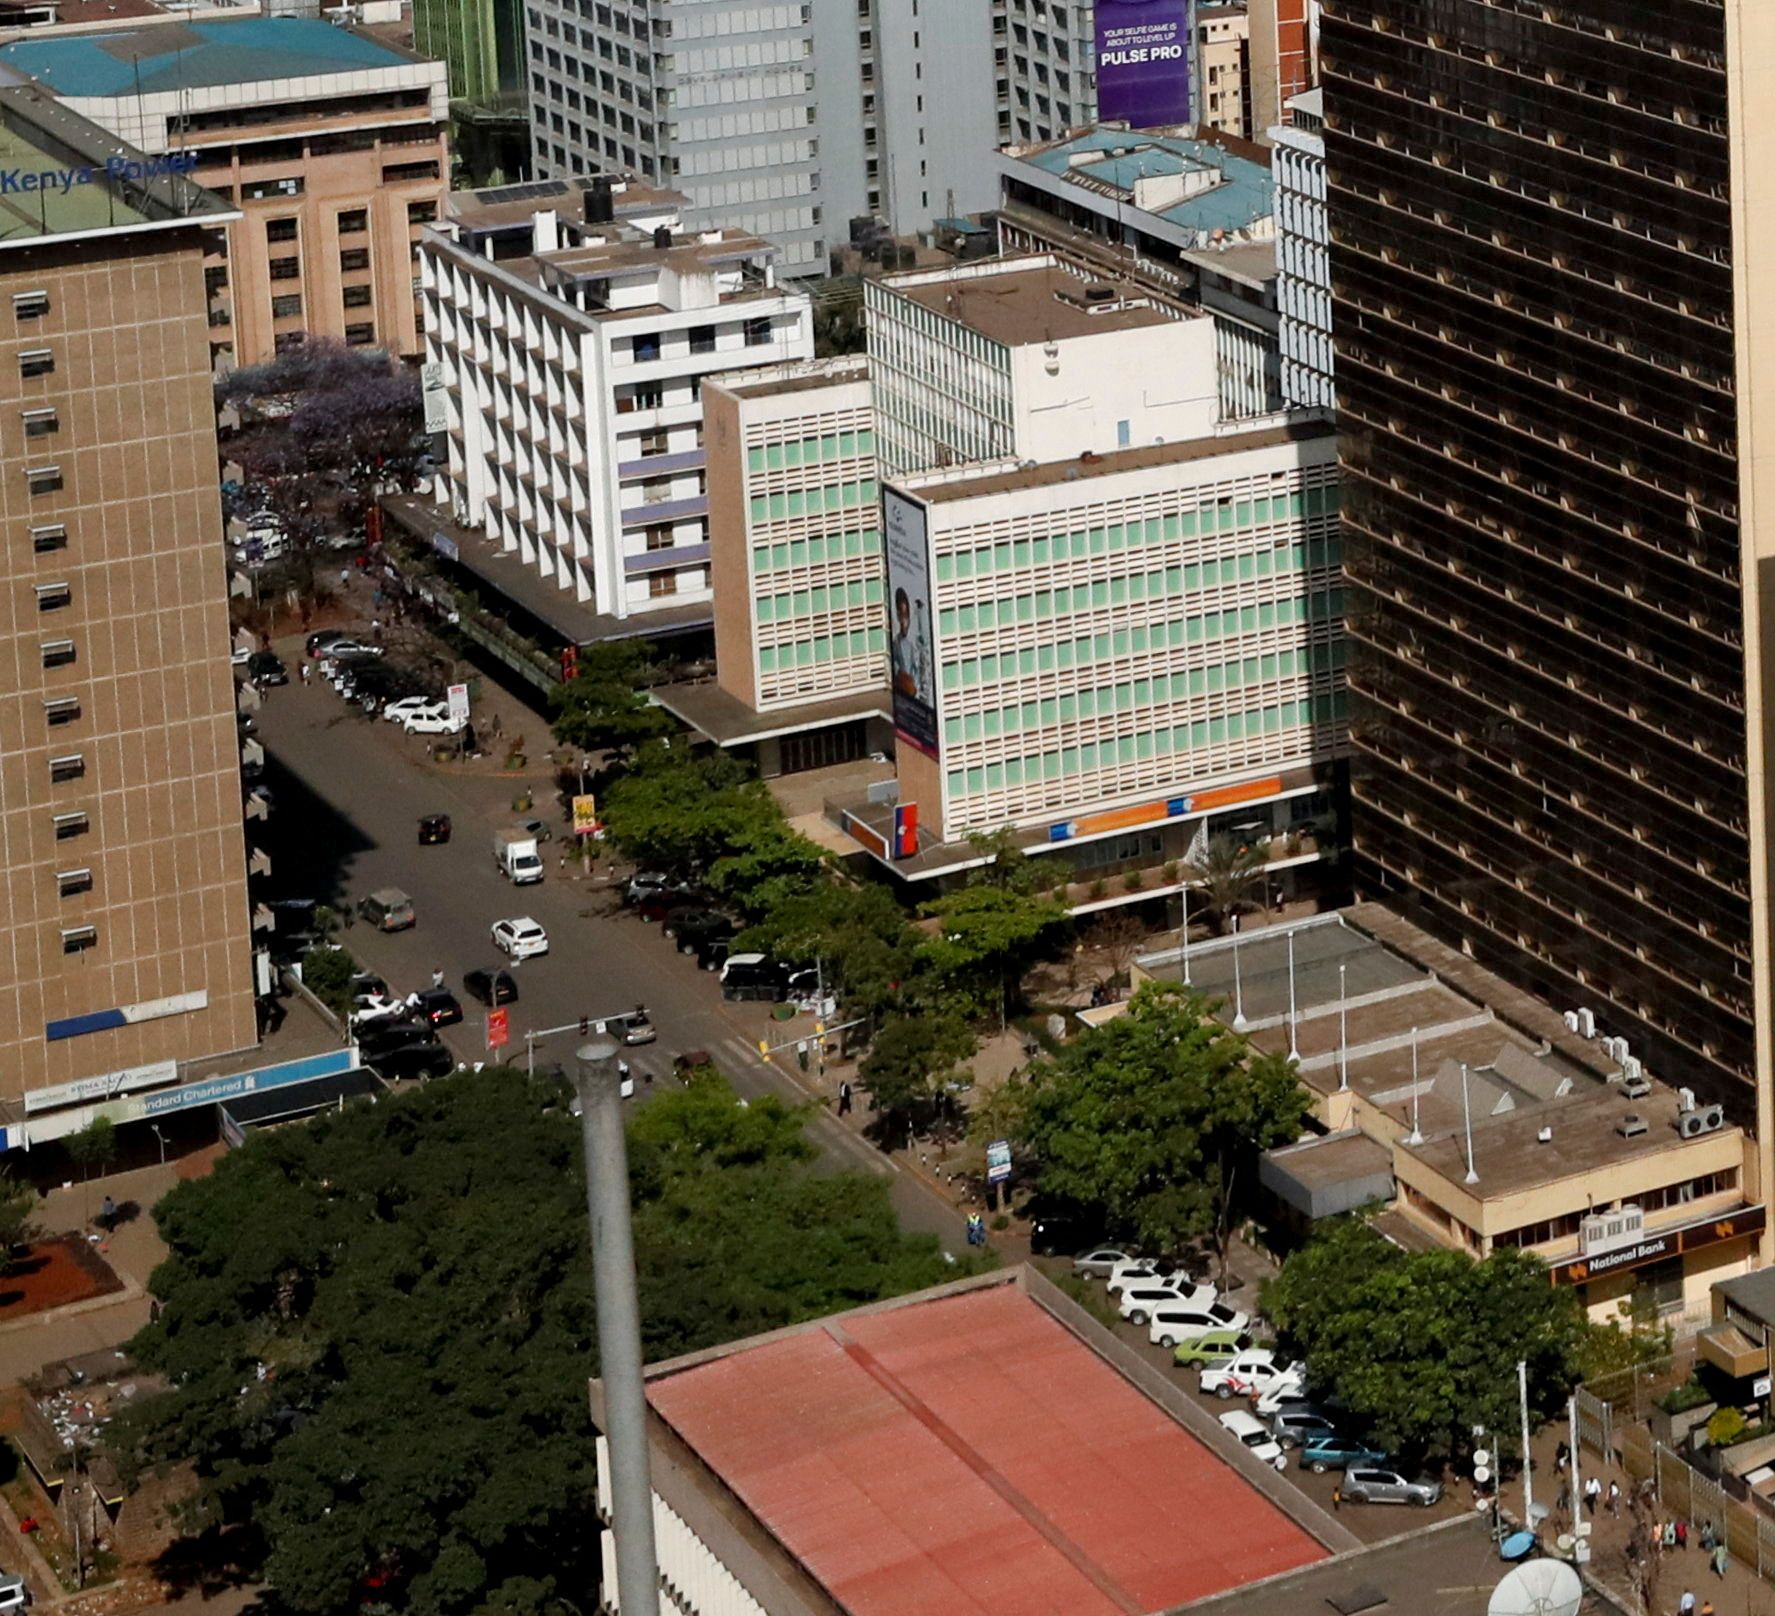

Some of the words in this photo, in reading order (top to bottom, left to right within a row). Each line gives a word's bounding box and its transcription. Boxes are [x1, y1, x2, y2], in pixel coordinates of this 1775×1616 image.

[1104, 28, 1124, 38] YOUR
[1125, 25, 1147, 36] SELFIE
[1148, 23, 1169, 33] GAME
[1169, 22, 1178, 31] IS
[1106, 37, 1131, 47] ABOUT
[1132, 35, 1142, 44] TO
[1143, 33, 1164, 43] LEVEL
[1164, 32, 1176, 41] UP
[1101, 48, 1149, 66] PULSE
[1150, 45, 1182, 61] PRO
[1, 167, 93, 195] Kenya
[106, 153, 199, 181] Power
[127, 1093, 182, 1112] Standard
[183, 1080, 242, 1102] Chartered
[1589, 1250, 1637, 1272] National
[1638, 1240, 1666, 1258] Bank
